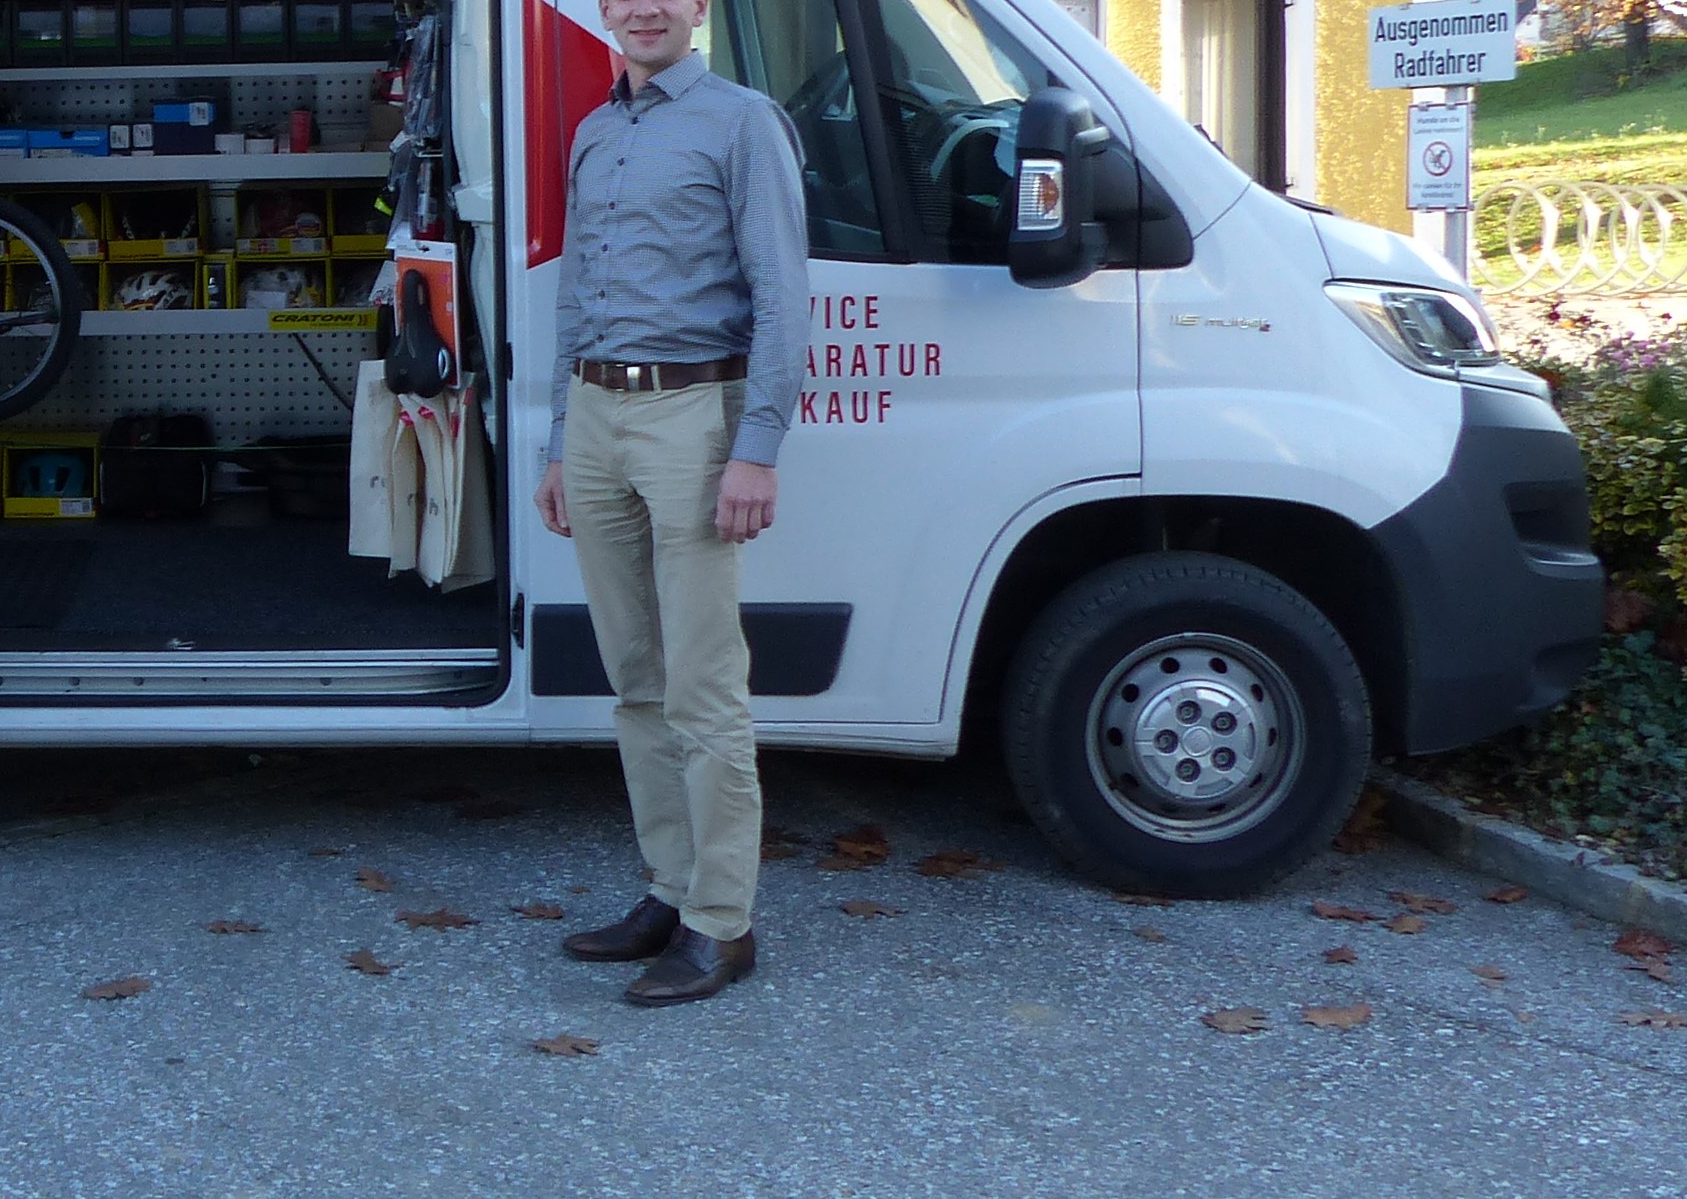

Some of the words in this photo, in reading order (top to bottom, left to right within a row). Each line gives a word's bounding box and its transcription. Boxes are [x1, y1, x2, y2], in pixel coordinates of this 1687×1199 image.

[1375, 11, 1509, 46] Ausgenommen
[1394, 49, 1487, 78] Radfahrer
[272, 313, 355, 323] CRATONI
[810, 295, 879, 330] ICE
[800, 390, 892, 424] KAUF
